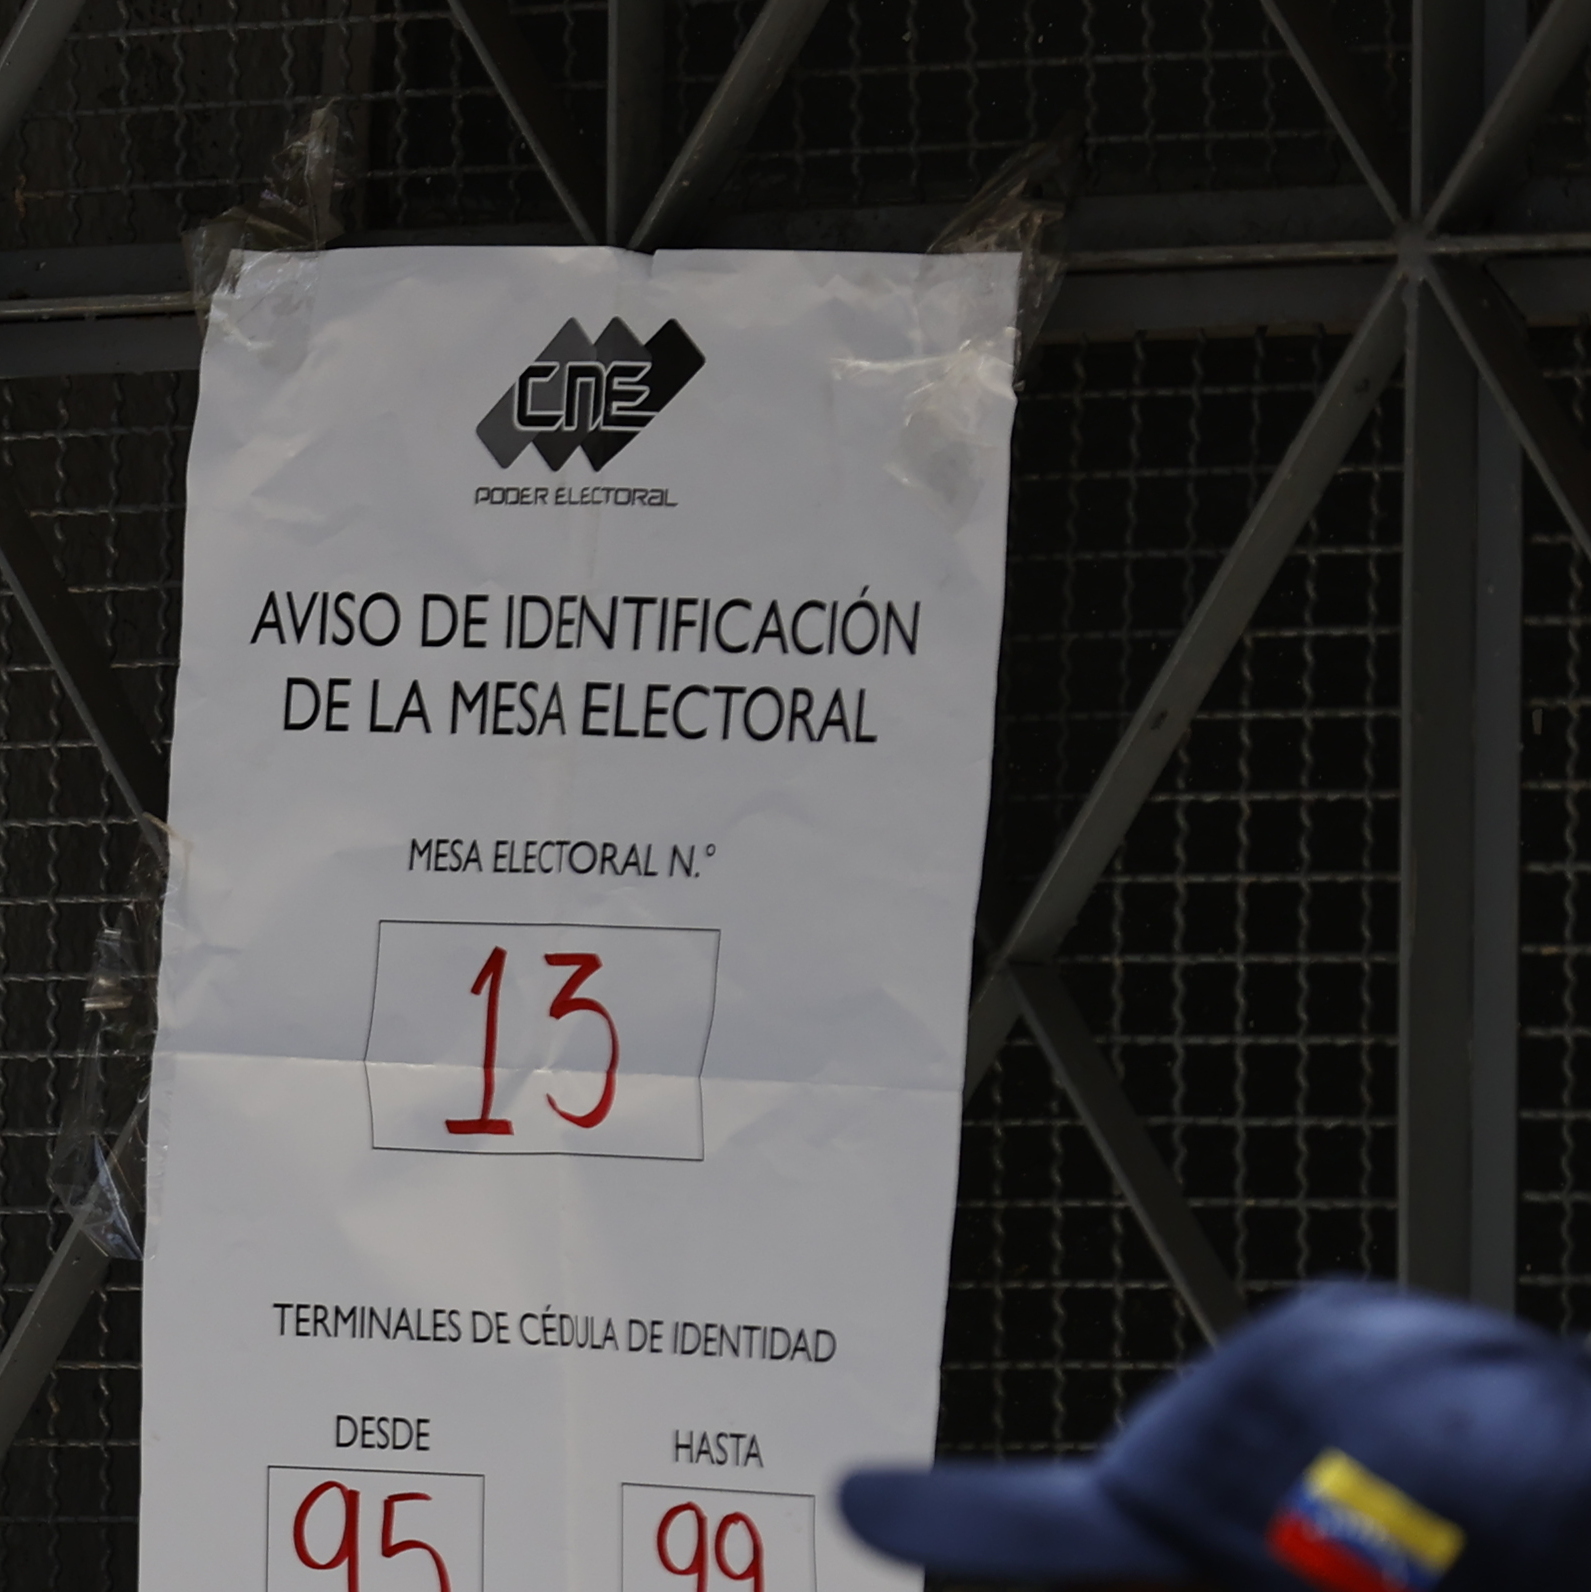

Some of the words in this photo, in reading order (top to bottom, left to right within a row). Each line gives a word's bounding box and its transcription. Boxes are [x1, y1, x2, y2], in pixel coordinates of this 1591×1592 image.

[475, 486, 549, 505] PODER
[250, 590, 401, 647] AVISO
[422, 594, 488, 649] DE
[505, 585, 921, 656] IDENTIFICACIÓN
[283, 676, 351, 732] DE
[369, 679, 432, 734] LA
[450, 680, 567, 736] MESA
[581, 682, 878, 744] ELECTORAL
[408, 838, 483, 873] MESA
[493, 840, 659, 877] ELECTORAL
[445, 946, 620, 1136] 13
[273, 1302, 461, 1343] TERMINALES
[472, 1310, 511, 1346] DE
[518, 1305, 617, 1351] CÉDULA
[627, 1319, 664, 1354] DE
[673, 1320, 836, 1364] IDENTIDAD
[335, 1415, 431, 1451] DESDE
[674, 1429, 764, 1469] HASTA
